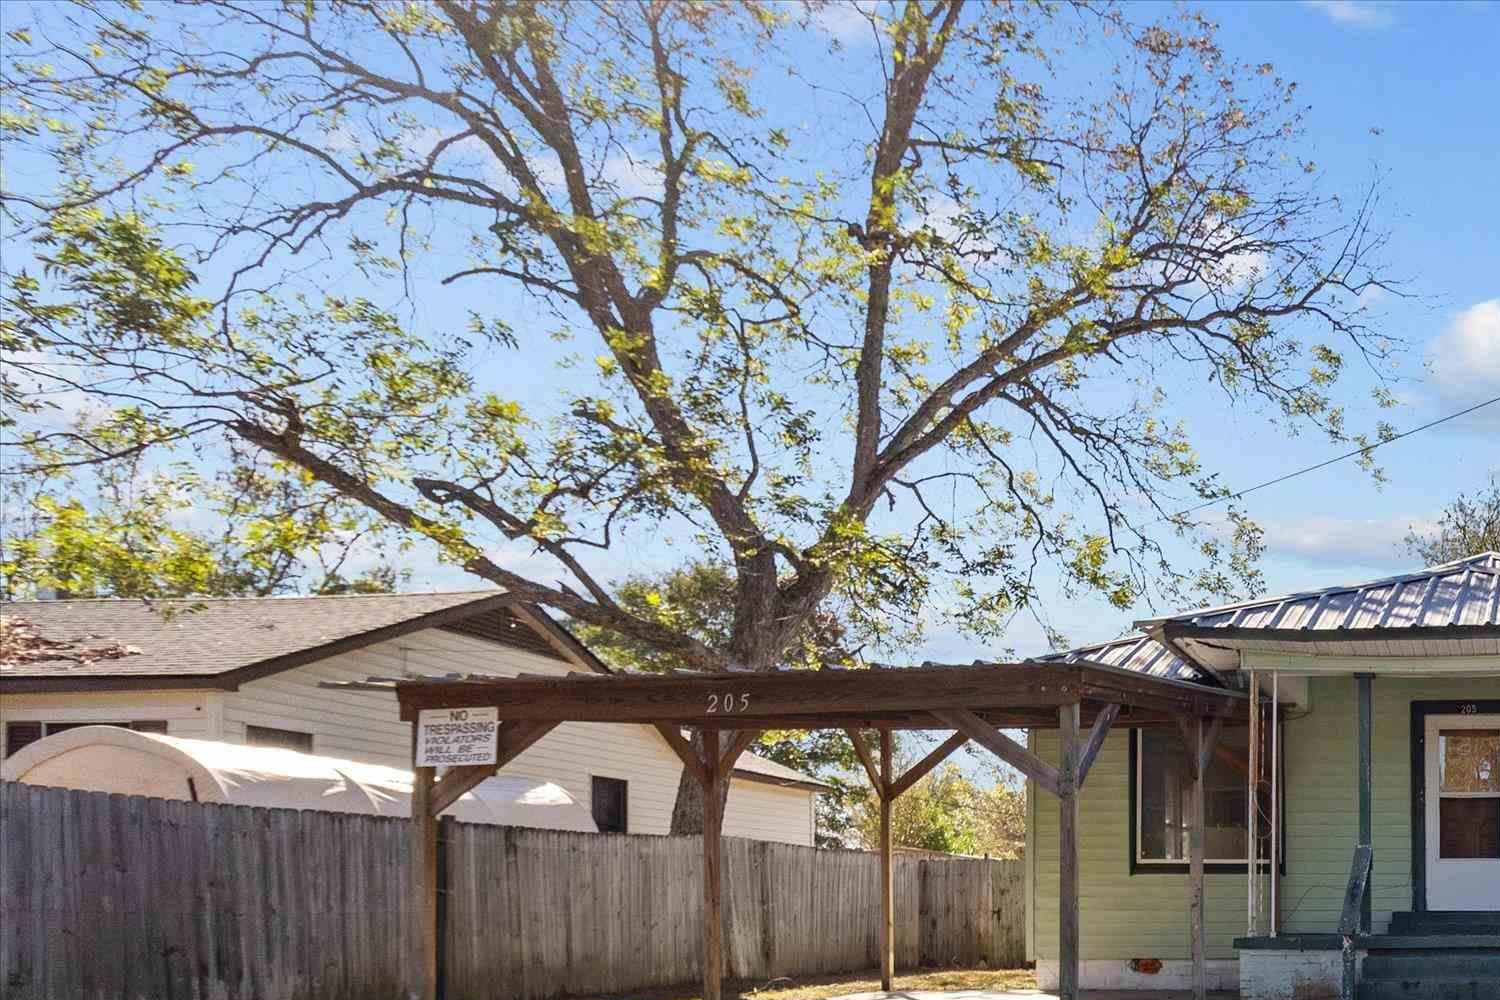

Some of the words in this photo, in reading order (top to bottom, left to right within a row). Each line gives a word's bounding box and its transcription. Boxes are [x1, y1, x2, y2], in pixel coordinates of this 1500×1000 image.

[706, 692, 750, 713] 205
[1460, 704, 1478, 714] 205
[449, 710, 469, 721] NO
[424, 721, 495, 736] TRESPASSING
[425, 734, 491, 745] VIOLATORS
[425, 745, 449, 754] WILL
[458, 744, 473, 753] BE
[425, 752, 490, 763] PROSECUTED
